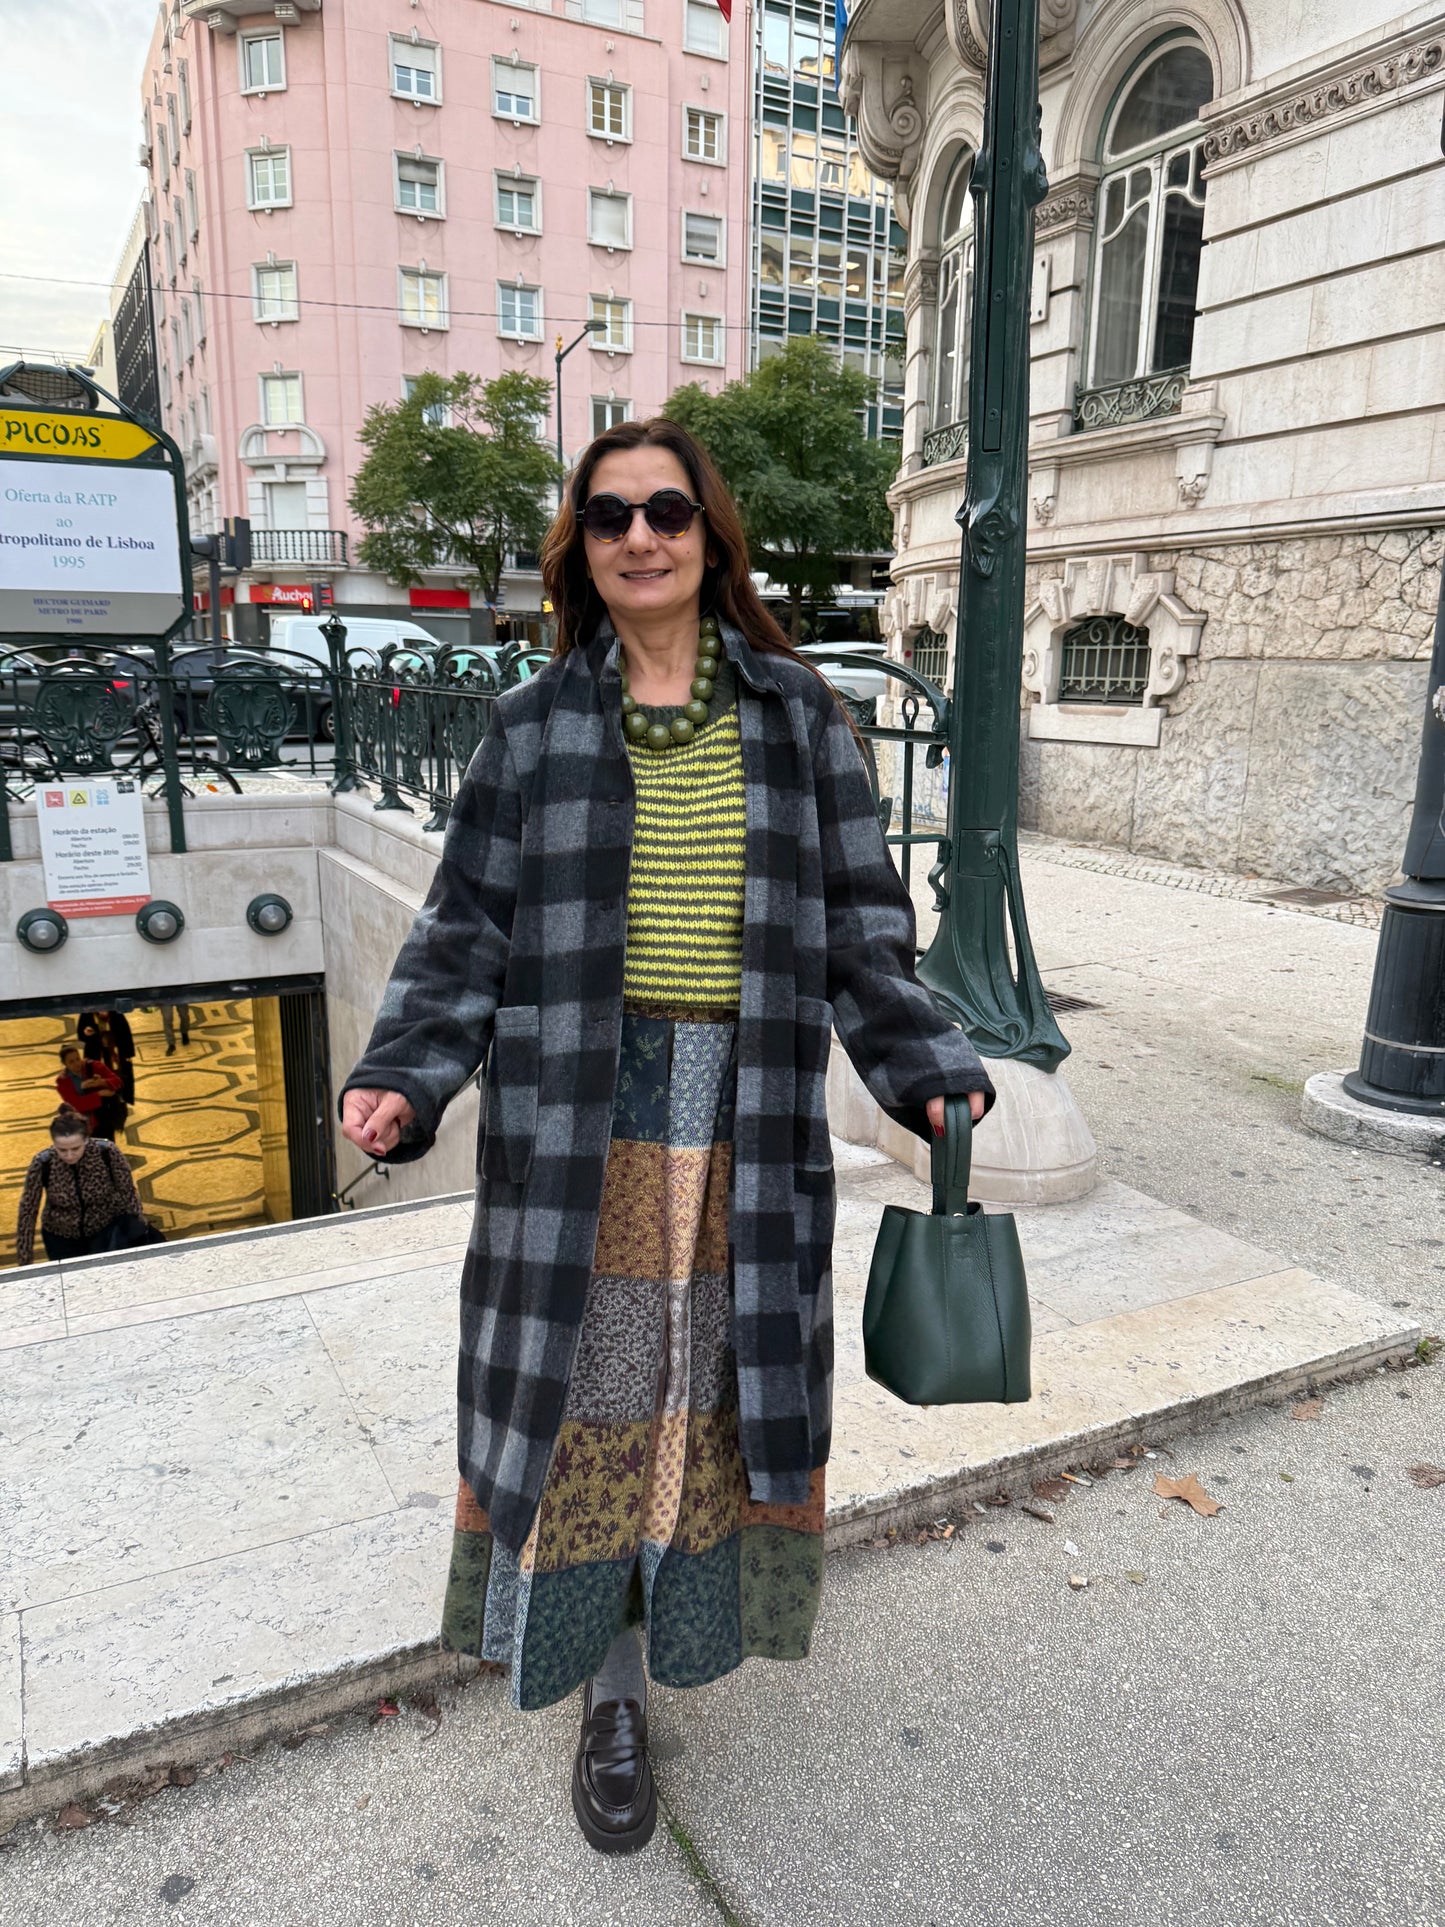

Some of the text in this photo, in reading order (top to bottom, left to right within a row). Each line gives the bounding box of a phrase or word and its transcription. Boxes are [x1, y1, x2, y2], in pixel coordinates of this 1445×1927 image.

[5, 421, 101, 447] PICOAS
[5, 488, 117, 506] Oferta da RATP
[56, 517, 73, 528] ao
[86, 535, 103, 548] de
[106, 536, 155, 550] Lisboa
[52, 555, 86, 569] 1995
[33, 598, 111, 607] HECTOR GUIMARD
[38, 607, 69, 615] METRO
[84, 608, 108, 616] PARIS
[90, 827, 117, 836] estação
